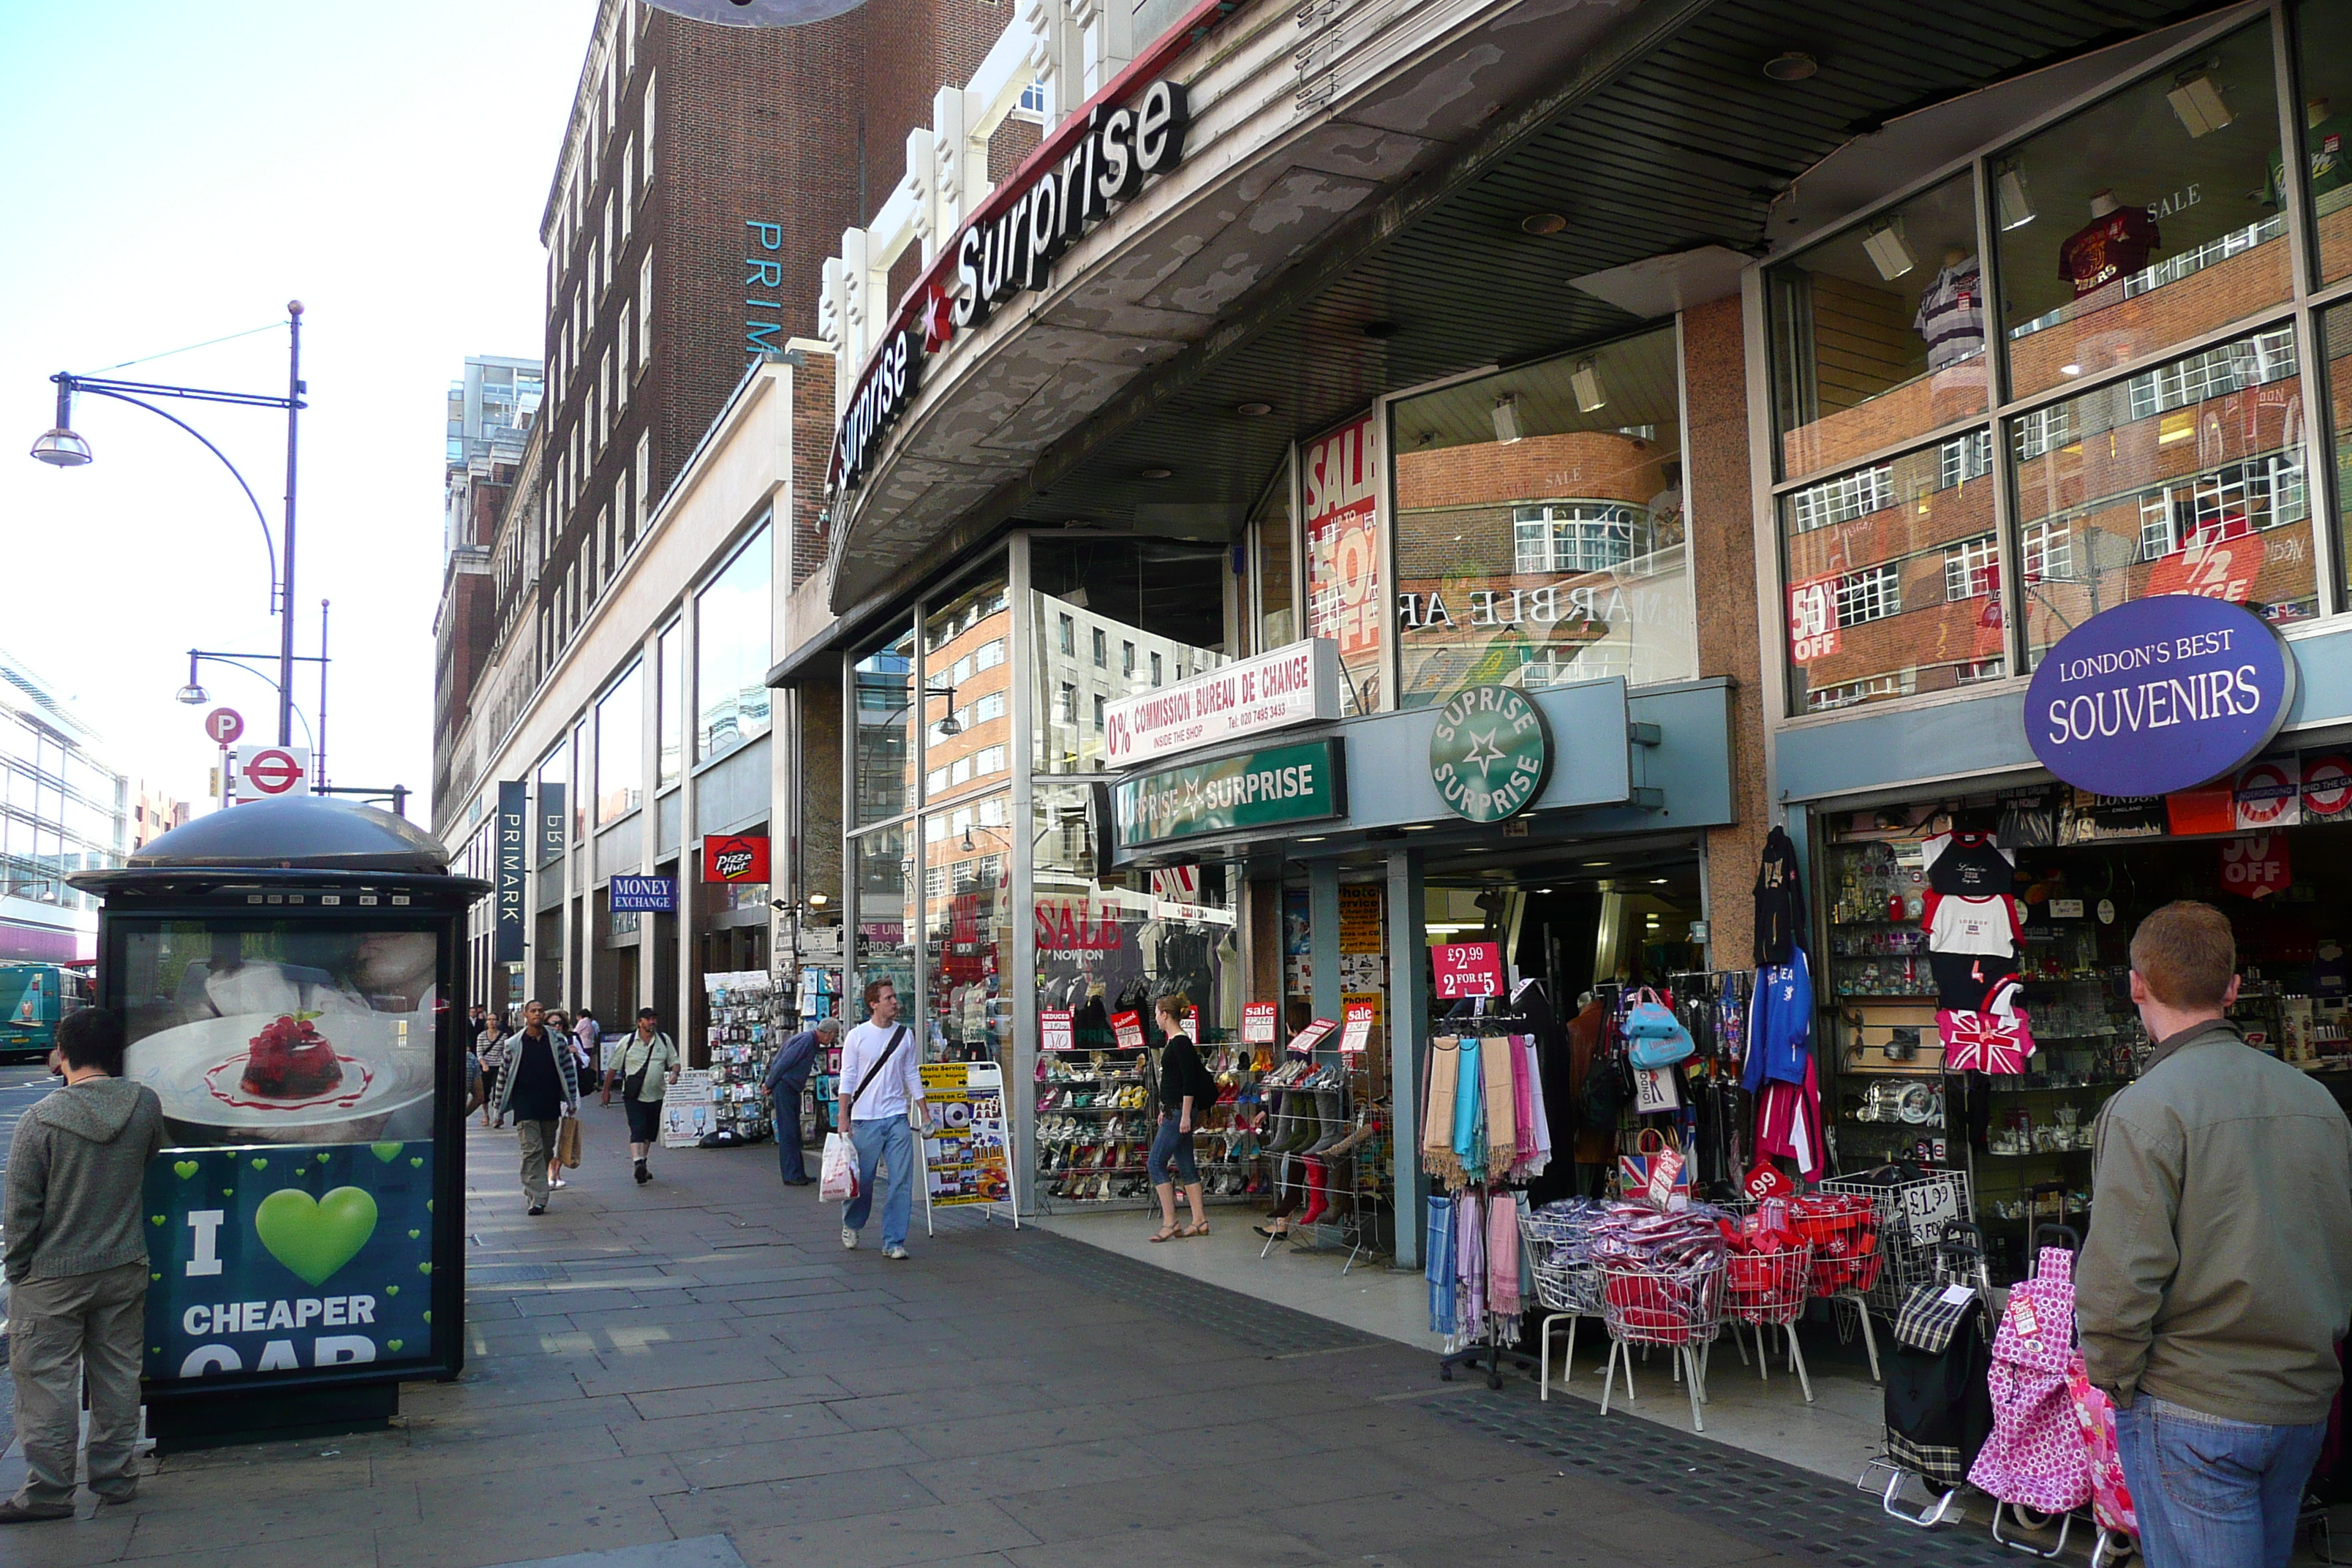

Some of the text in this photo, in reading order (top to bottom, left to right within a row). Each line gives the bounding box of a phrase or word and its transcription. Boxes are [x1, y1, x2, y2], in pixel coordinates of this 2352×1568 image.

[2147, 183, 2201, 223] SALE
[747, 220, 781, 369] PRIM
[1545, 467, 1582, 489] SALE
[1344, 509, 1356, 523] TO
[1793, 579, 1836, 641] 50%
[1794, 631, 1835, 661] OFF
[2059, 629, 2234, 682] LONDON'S BEST
[1108, 655, 1308, 755] 0% COMMISSION BUREAU DE CHANGE
[1227, 715, 1240, 730] Tel:
[1252, 707, 1269, 723] 7495
[1270, 702, 1286, 717] 3433
[1436, 687, 1535, 742] SUPRISE
[2048, 664, 2261, 745] SOUVENIRS
[217, 715, 237, 739] P
[1153, 724, 1204, 749] INSIDE THE SHOP
[1206, 764, 1314, 810] SURPRISE
[1433, 754, 1539, 816] SURPRISE
[2236, 786, 2293, 800] UNDERGROUND
[2322, 780, 2339, 789] THE
[502, 814, 520, 921] PRIMARK
[717, 853, 753, 870] Pizza
[723, 862, 748, 875] Hut
[2225, 861, 2280, 883] OFF
[615, 879, 671, 894] MONEY
[614, 897, 671, 908] EXCHANGE
[1035, 898, 1122, 950] SALE
[1053, 950, 1104, 960] NOW ON
[1447, 946, 1483, 969] £2.99
[1443, 971, 1495, 995] 2 FOR £5
[1245, 1005, 1275, 1016] sale
[1347, 1006, 1372, 1021] sale
[1640, 1069, 1651, 1104] LONDO
[1910, 1186, 1948, 1217] £1.99
[185, 1209, 225, 1278] I
[182, 1294, 377, 1336] CHEAPER
